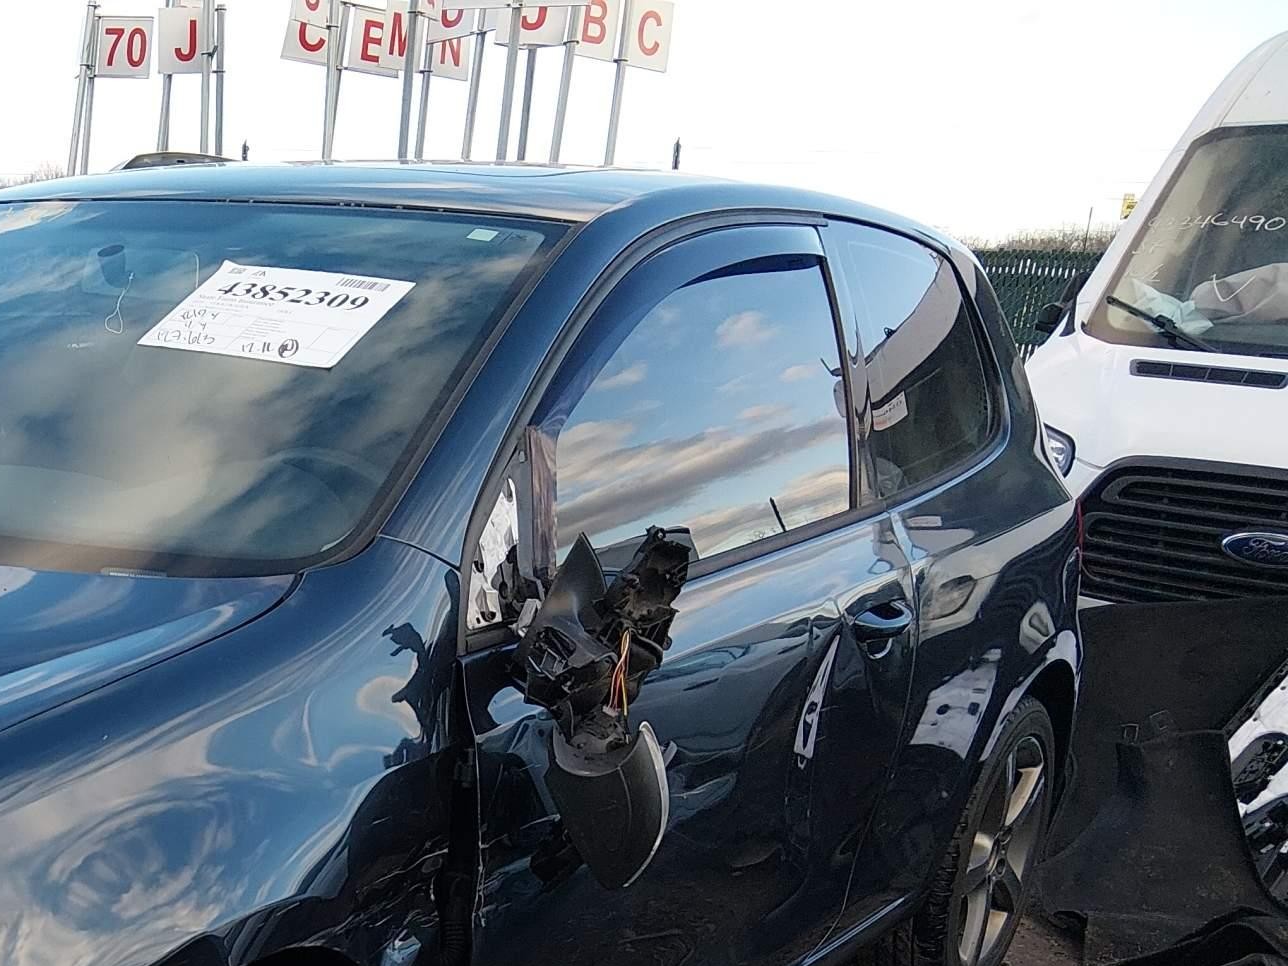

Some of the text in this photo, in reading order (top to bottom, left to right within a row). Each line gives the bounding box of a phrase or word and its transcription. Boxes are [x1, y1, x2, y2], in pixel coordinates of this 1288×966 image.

[174, 19, 197, 62] J
[360, 19, 385, 63] E
[581, 0, 608, 45] B
[637, 10, 663, 57] C
[104, 27, 147, 68] 70
[217, 281, 370, 311] 43852309
